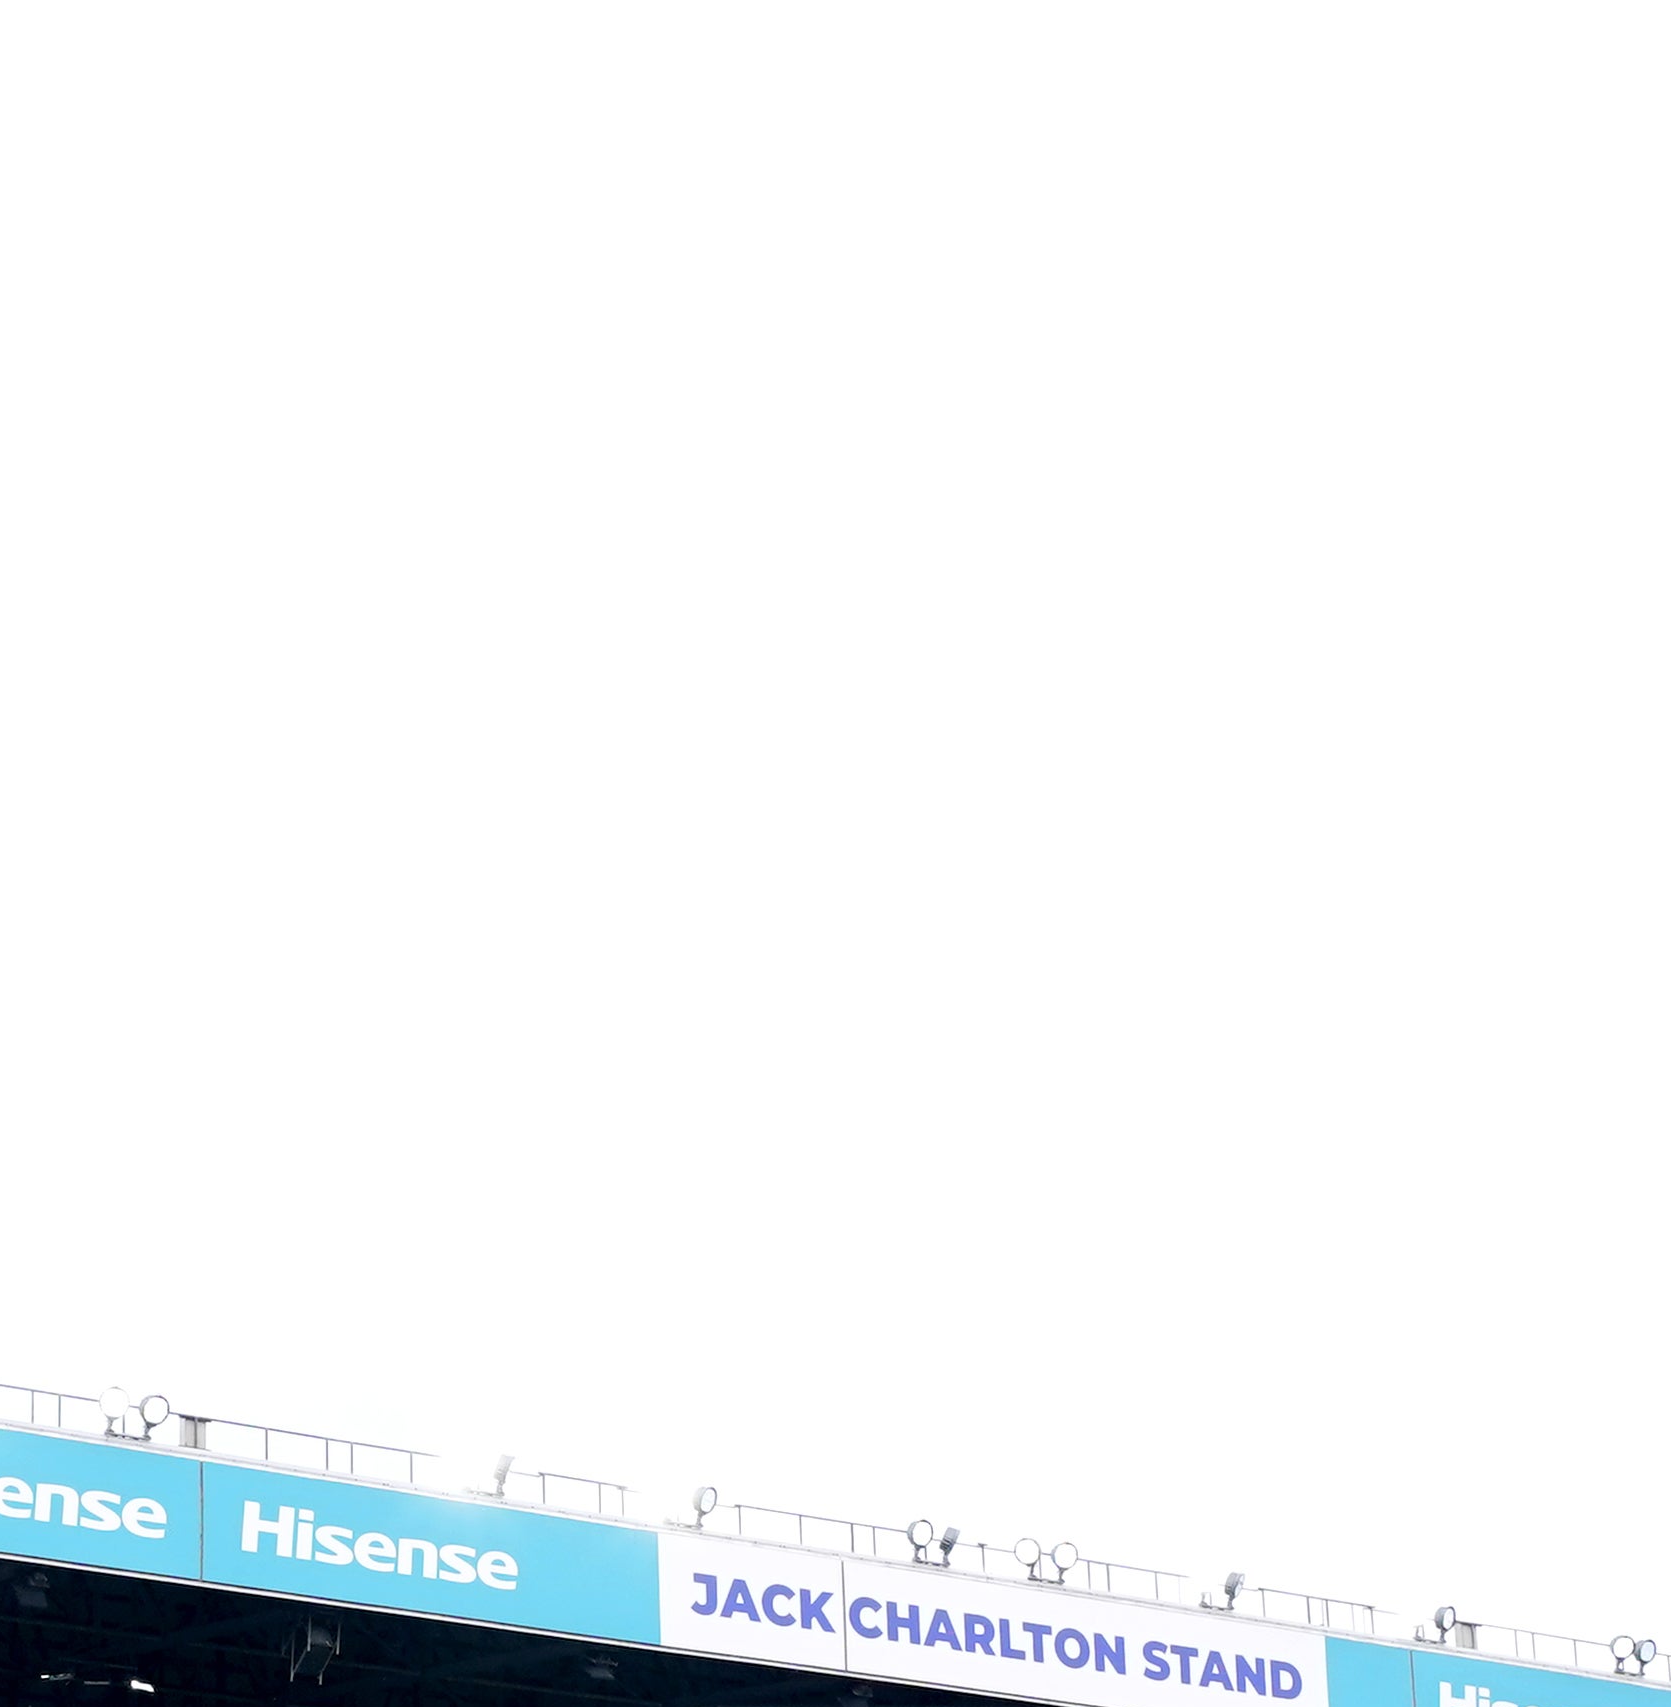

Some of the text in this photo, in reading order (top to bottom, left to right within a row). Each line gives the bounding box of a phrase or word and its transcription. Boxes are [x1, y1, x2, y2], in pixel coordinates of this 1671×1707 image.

[239, 1499, 518, 1591] Hisense
[691, 1572, 1304, 1701] JACK CHARLTON STAND
